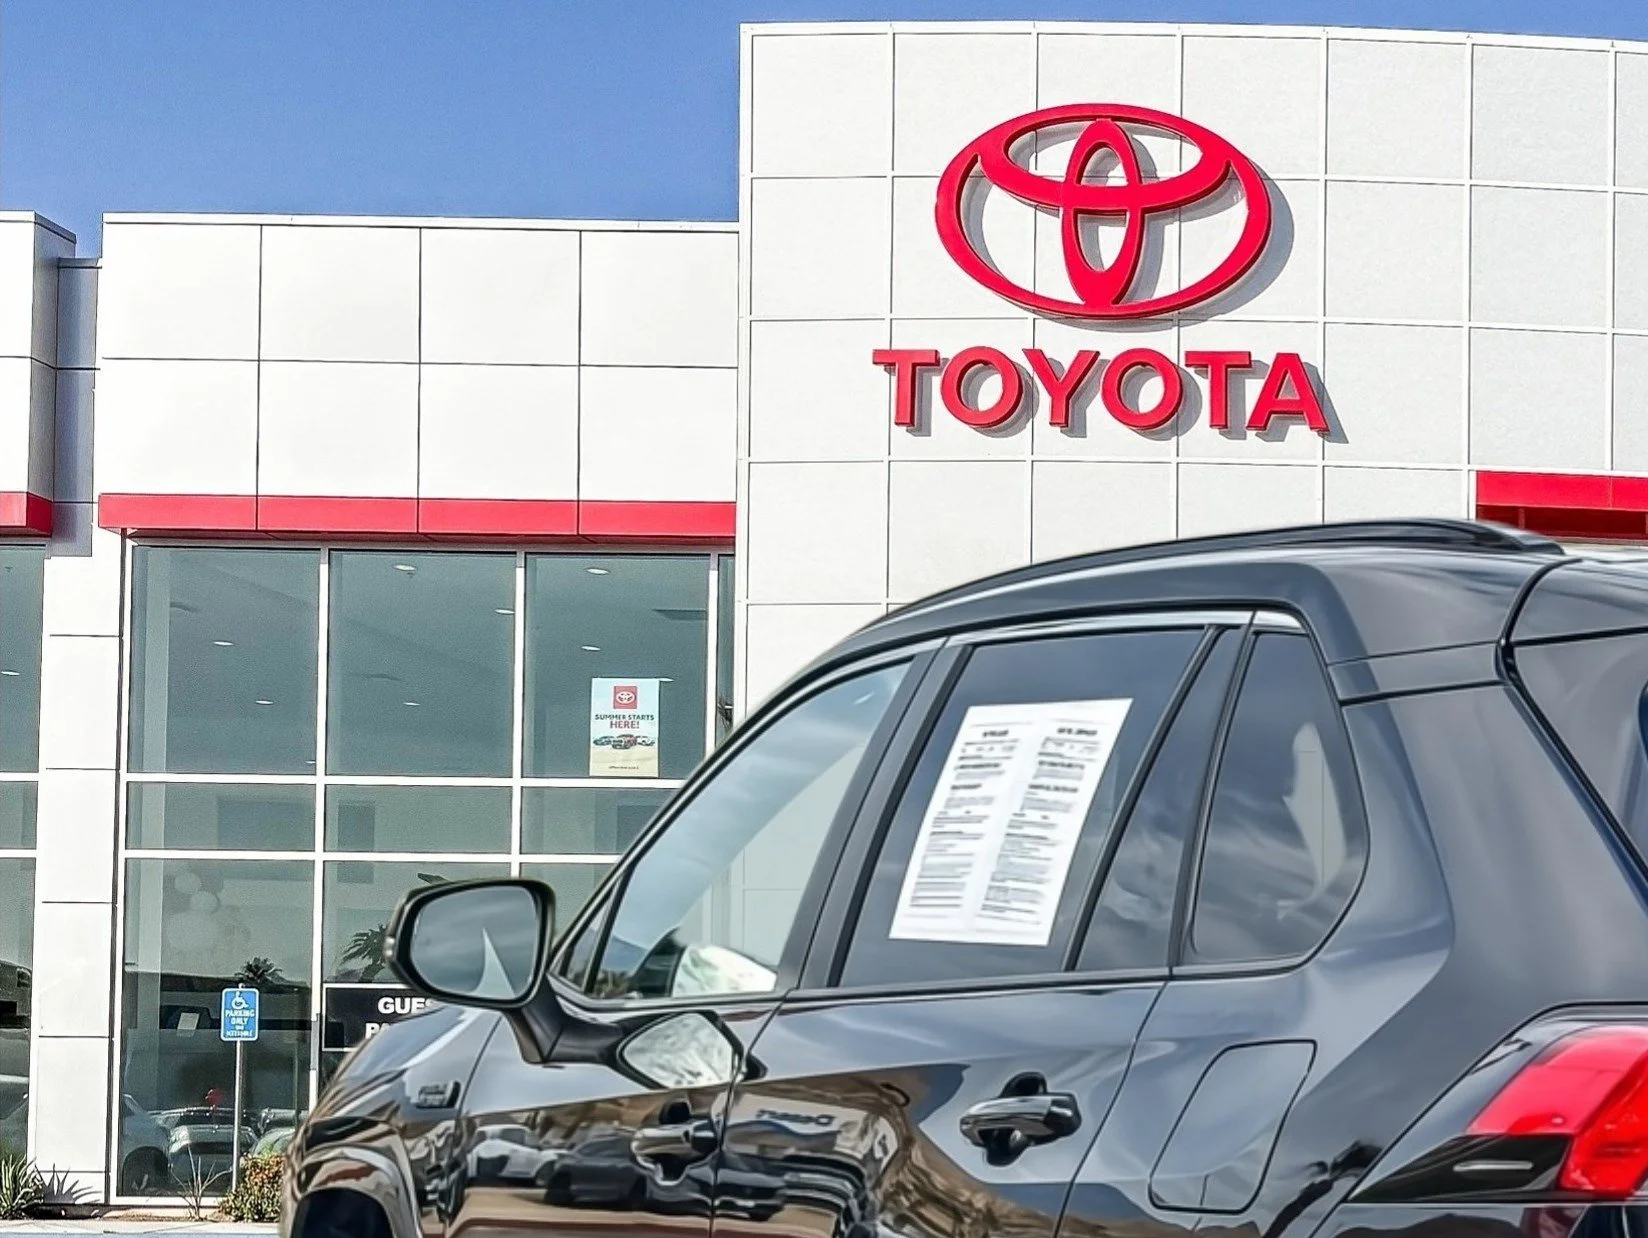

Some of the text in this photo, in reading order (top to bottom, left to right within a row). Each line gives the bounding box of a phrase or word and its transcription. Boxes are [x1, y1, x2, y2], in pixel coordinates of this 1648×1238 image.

[872, 346, 1330, 433] TOYOTA
[610, 720, 640, 729] HERE!
[377, 997, 431, 1014] GUE
[225, 1009, 255, 1018] PARKING
[230, 1016, 249, 1025] ONLY
